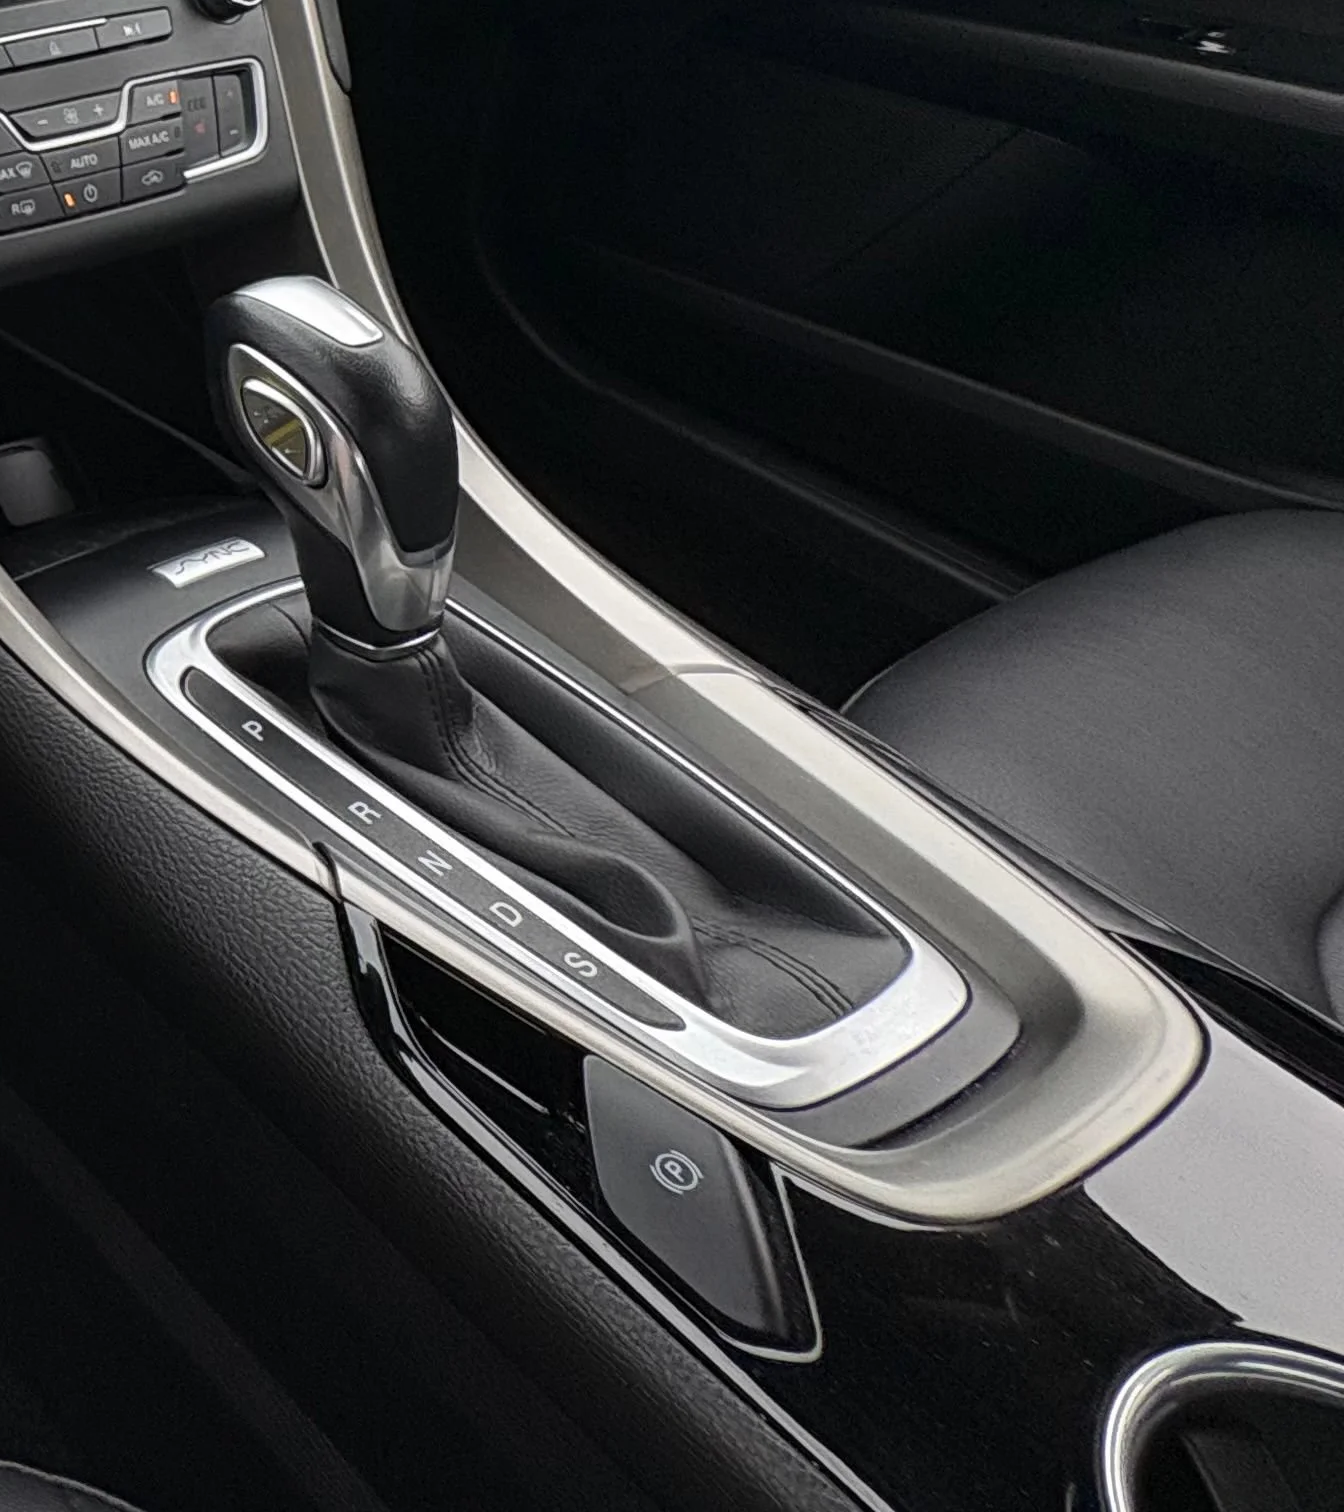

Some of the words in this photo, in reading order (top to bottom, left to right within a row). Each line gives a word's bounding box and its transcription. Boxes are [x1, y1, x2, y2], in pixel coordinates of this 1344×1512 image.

[146, 92, 164, 107] A/C
[128, 132, 151, 151] MAX
[152, 130, 170, 146] A/C
[70, 153, 98, 170] AUTO
[175, 541, 250, 576] SYNC
[241, 719, 265, 742] P
[348, 800, 381, 825] R
[418, 850, 453, 876] N
[489, 902, 523, 928] D
[563, 951, 598, 978] S
